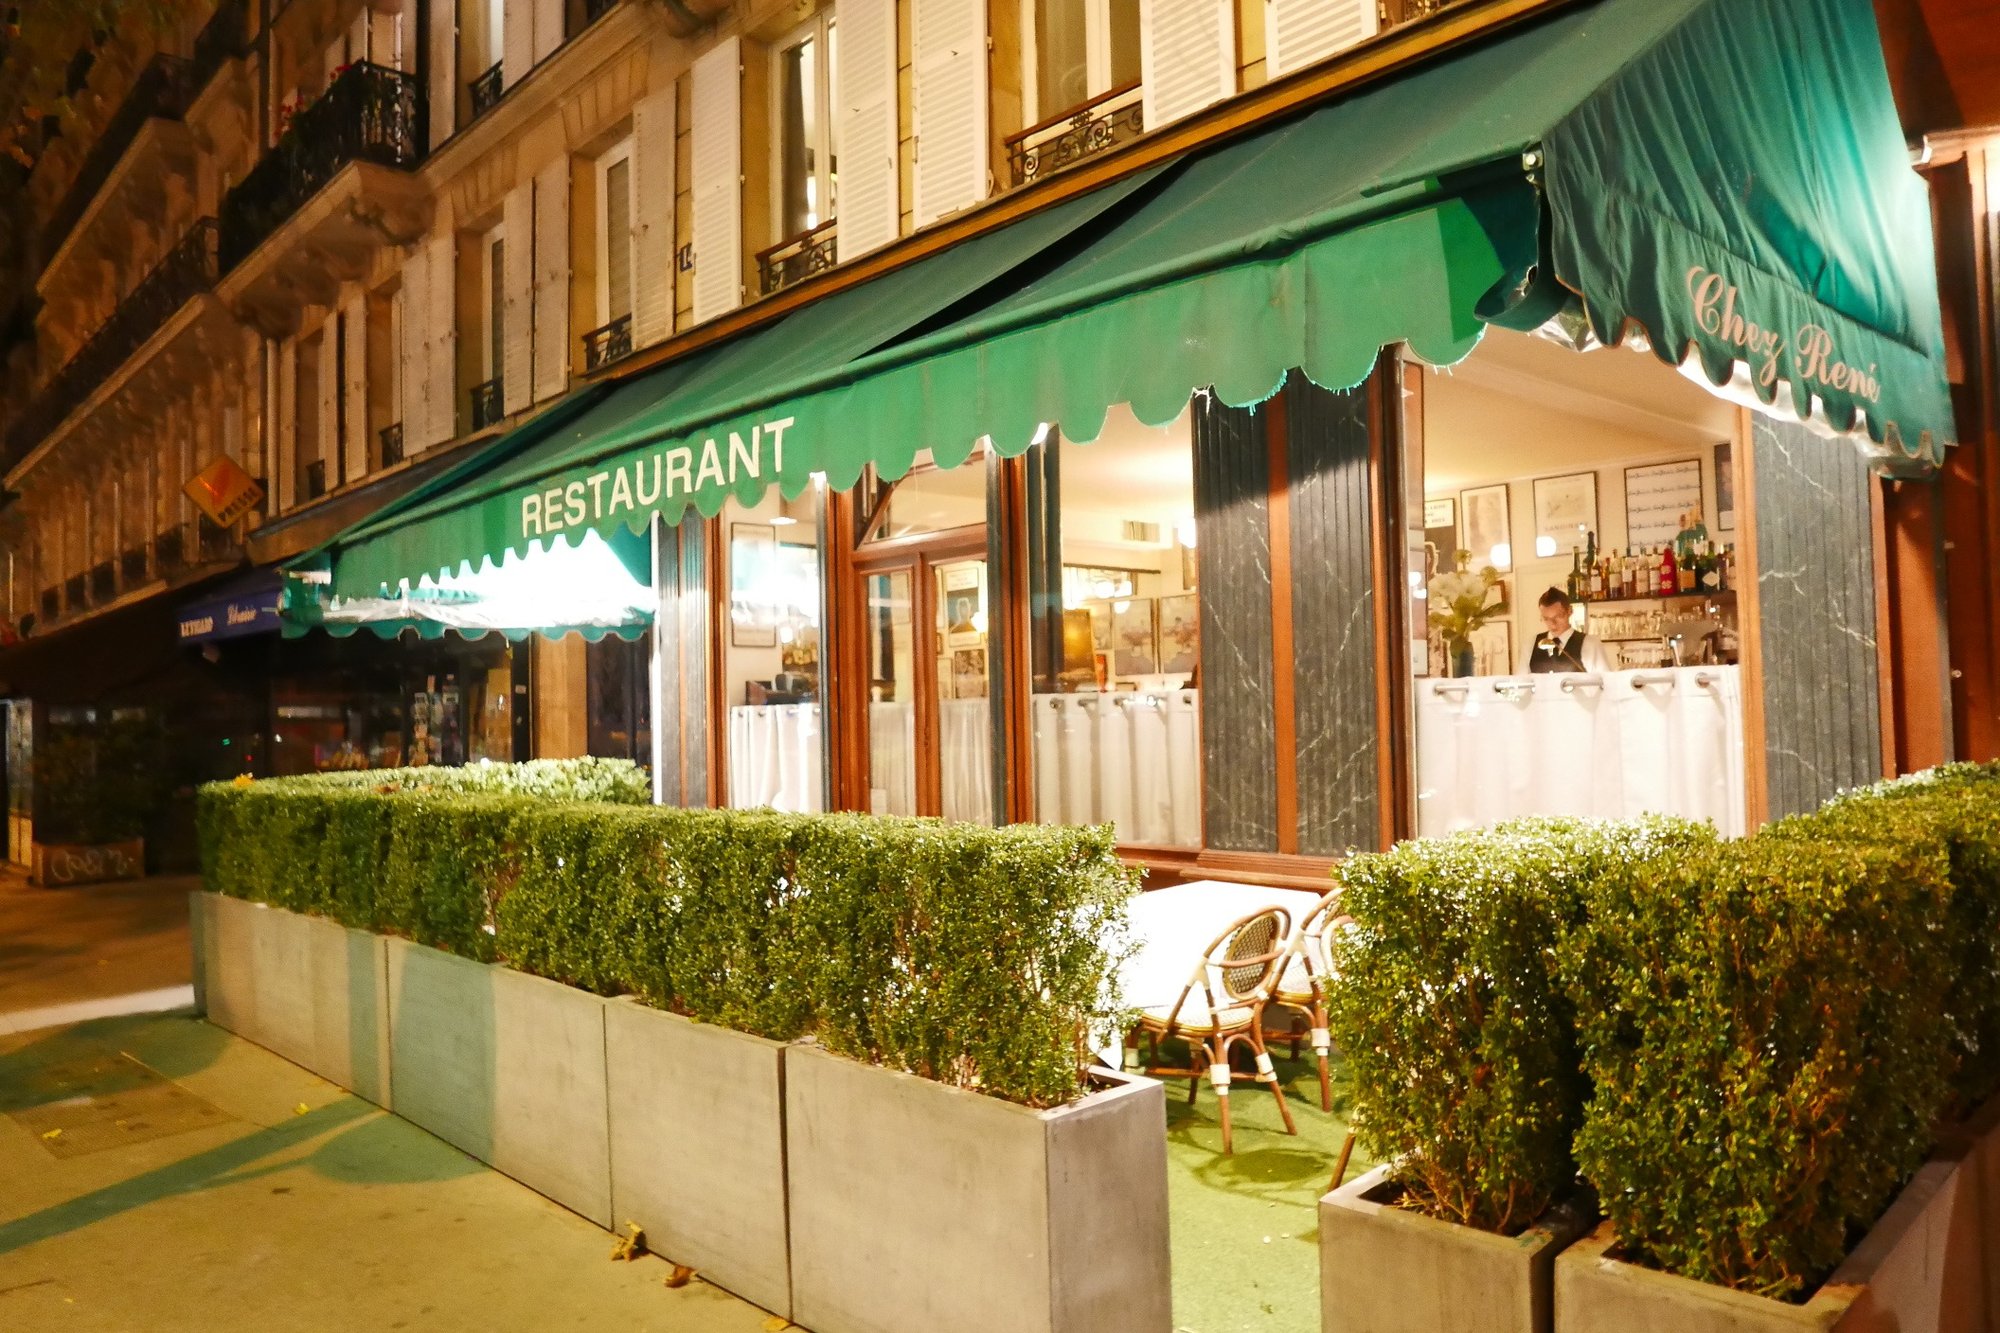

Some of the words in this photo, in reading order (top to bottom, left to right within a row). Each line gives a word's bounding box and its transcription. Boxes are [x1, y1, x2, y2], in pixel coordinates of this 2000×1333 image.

[1686, 265, 1787, 387] Chez
[1795, 324, 1881, 403] René
[216, 486, 258, 522] PRESSE
[522, 416, 795, 538] RESTAURANT
